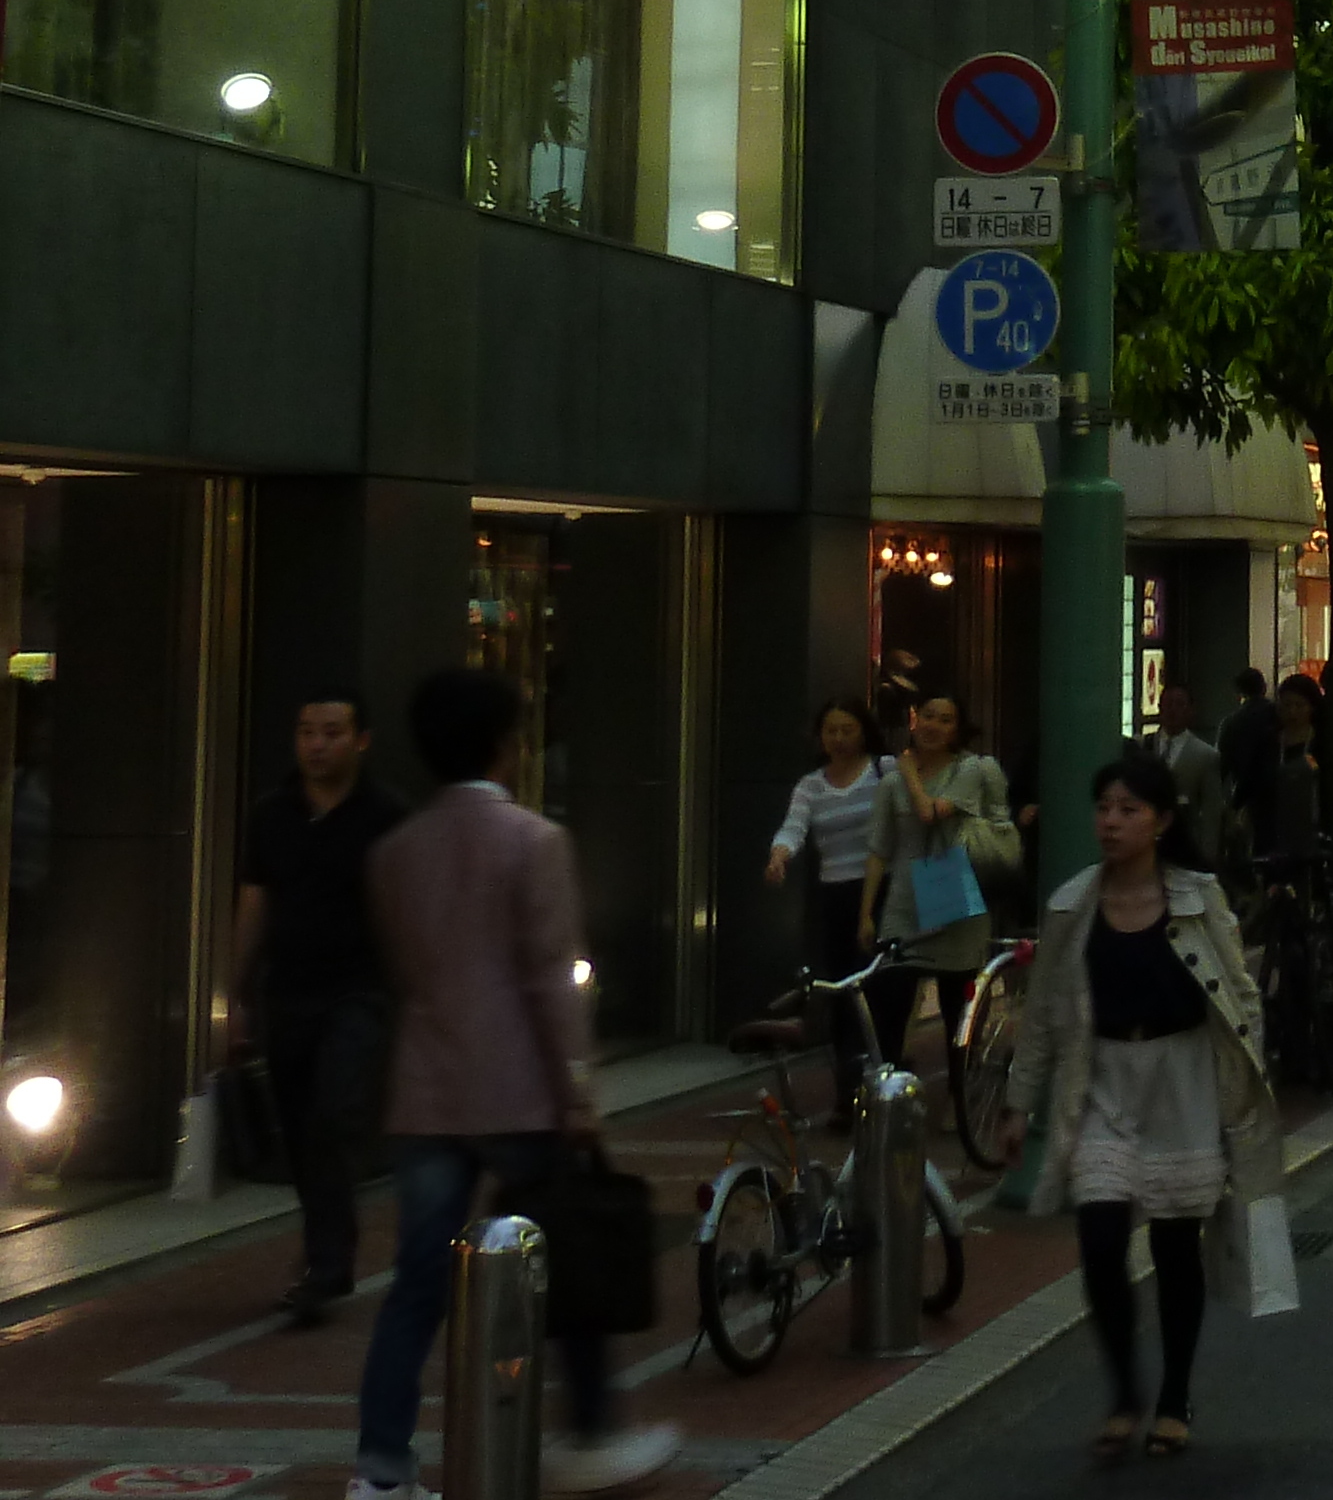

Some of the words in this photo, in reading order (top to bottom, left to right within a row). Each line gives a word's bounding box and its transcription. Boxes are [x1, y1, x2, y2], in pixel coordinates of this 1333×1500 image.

[1148, 3, 1277, 40] Musashino
[948, 187, 971, 211] 14
[1030, 186, 1044, 209] 7
[962, 279, 1010, 356] P
[996, 319, 1030, 354] 40
